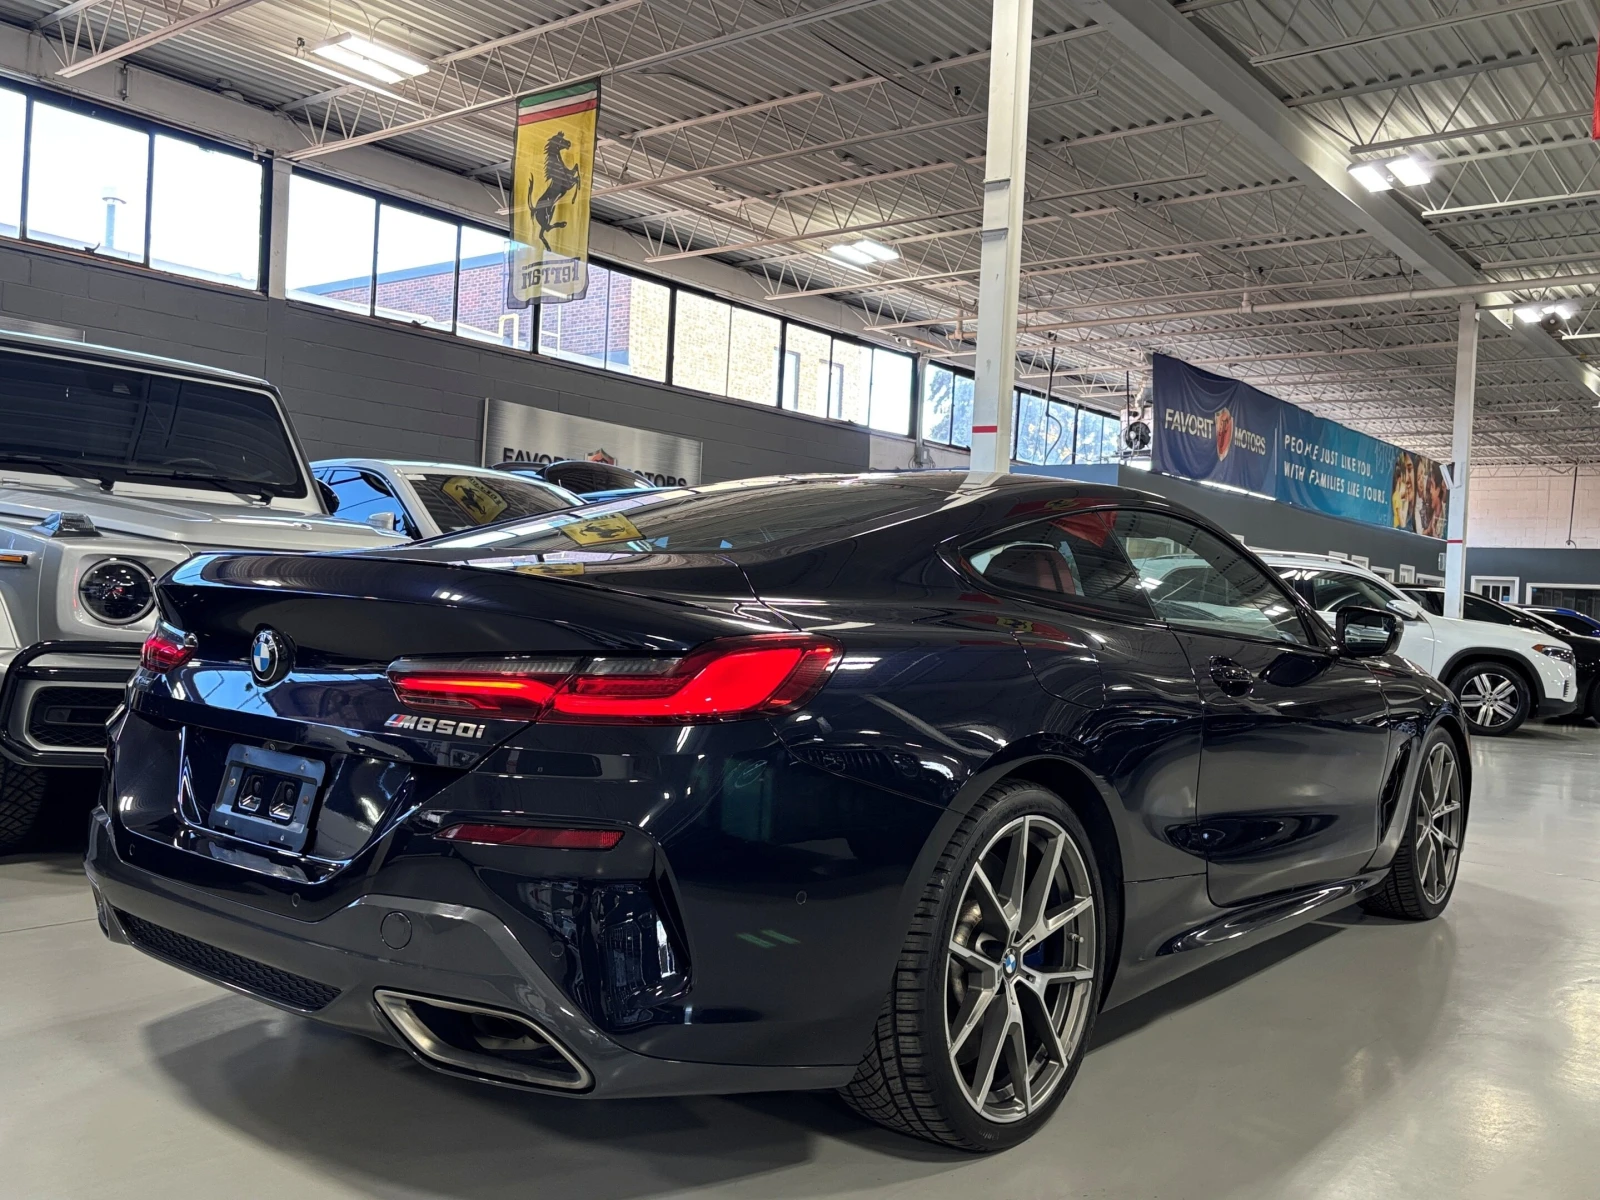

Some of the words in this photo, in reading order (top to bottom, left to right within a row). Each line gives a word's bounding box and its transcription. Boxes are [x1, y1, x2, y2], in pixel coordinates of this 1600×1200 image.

[1164, 408, 1214, 440] FAVORIT
[1234, 426, 1266, 455] MOTORS
[502, 447, 577, 463] FAVO
[626, 469, 687, 487] TORS
[1284, 461, 1306, 481] WITH
[1308, 469, 1345, 493] FAMILIES
[1347, 481, 1360, 498] LIKE
[1362, 486, 1388, 505] YOURS.
[1319, 448, 1339, 466] JUST
[1341, 454, 1356, 472] LIKE
[1357, 460, 1373, 479] YOU,
[385, 714, 486, 739] M850i
